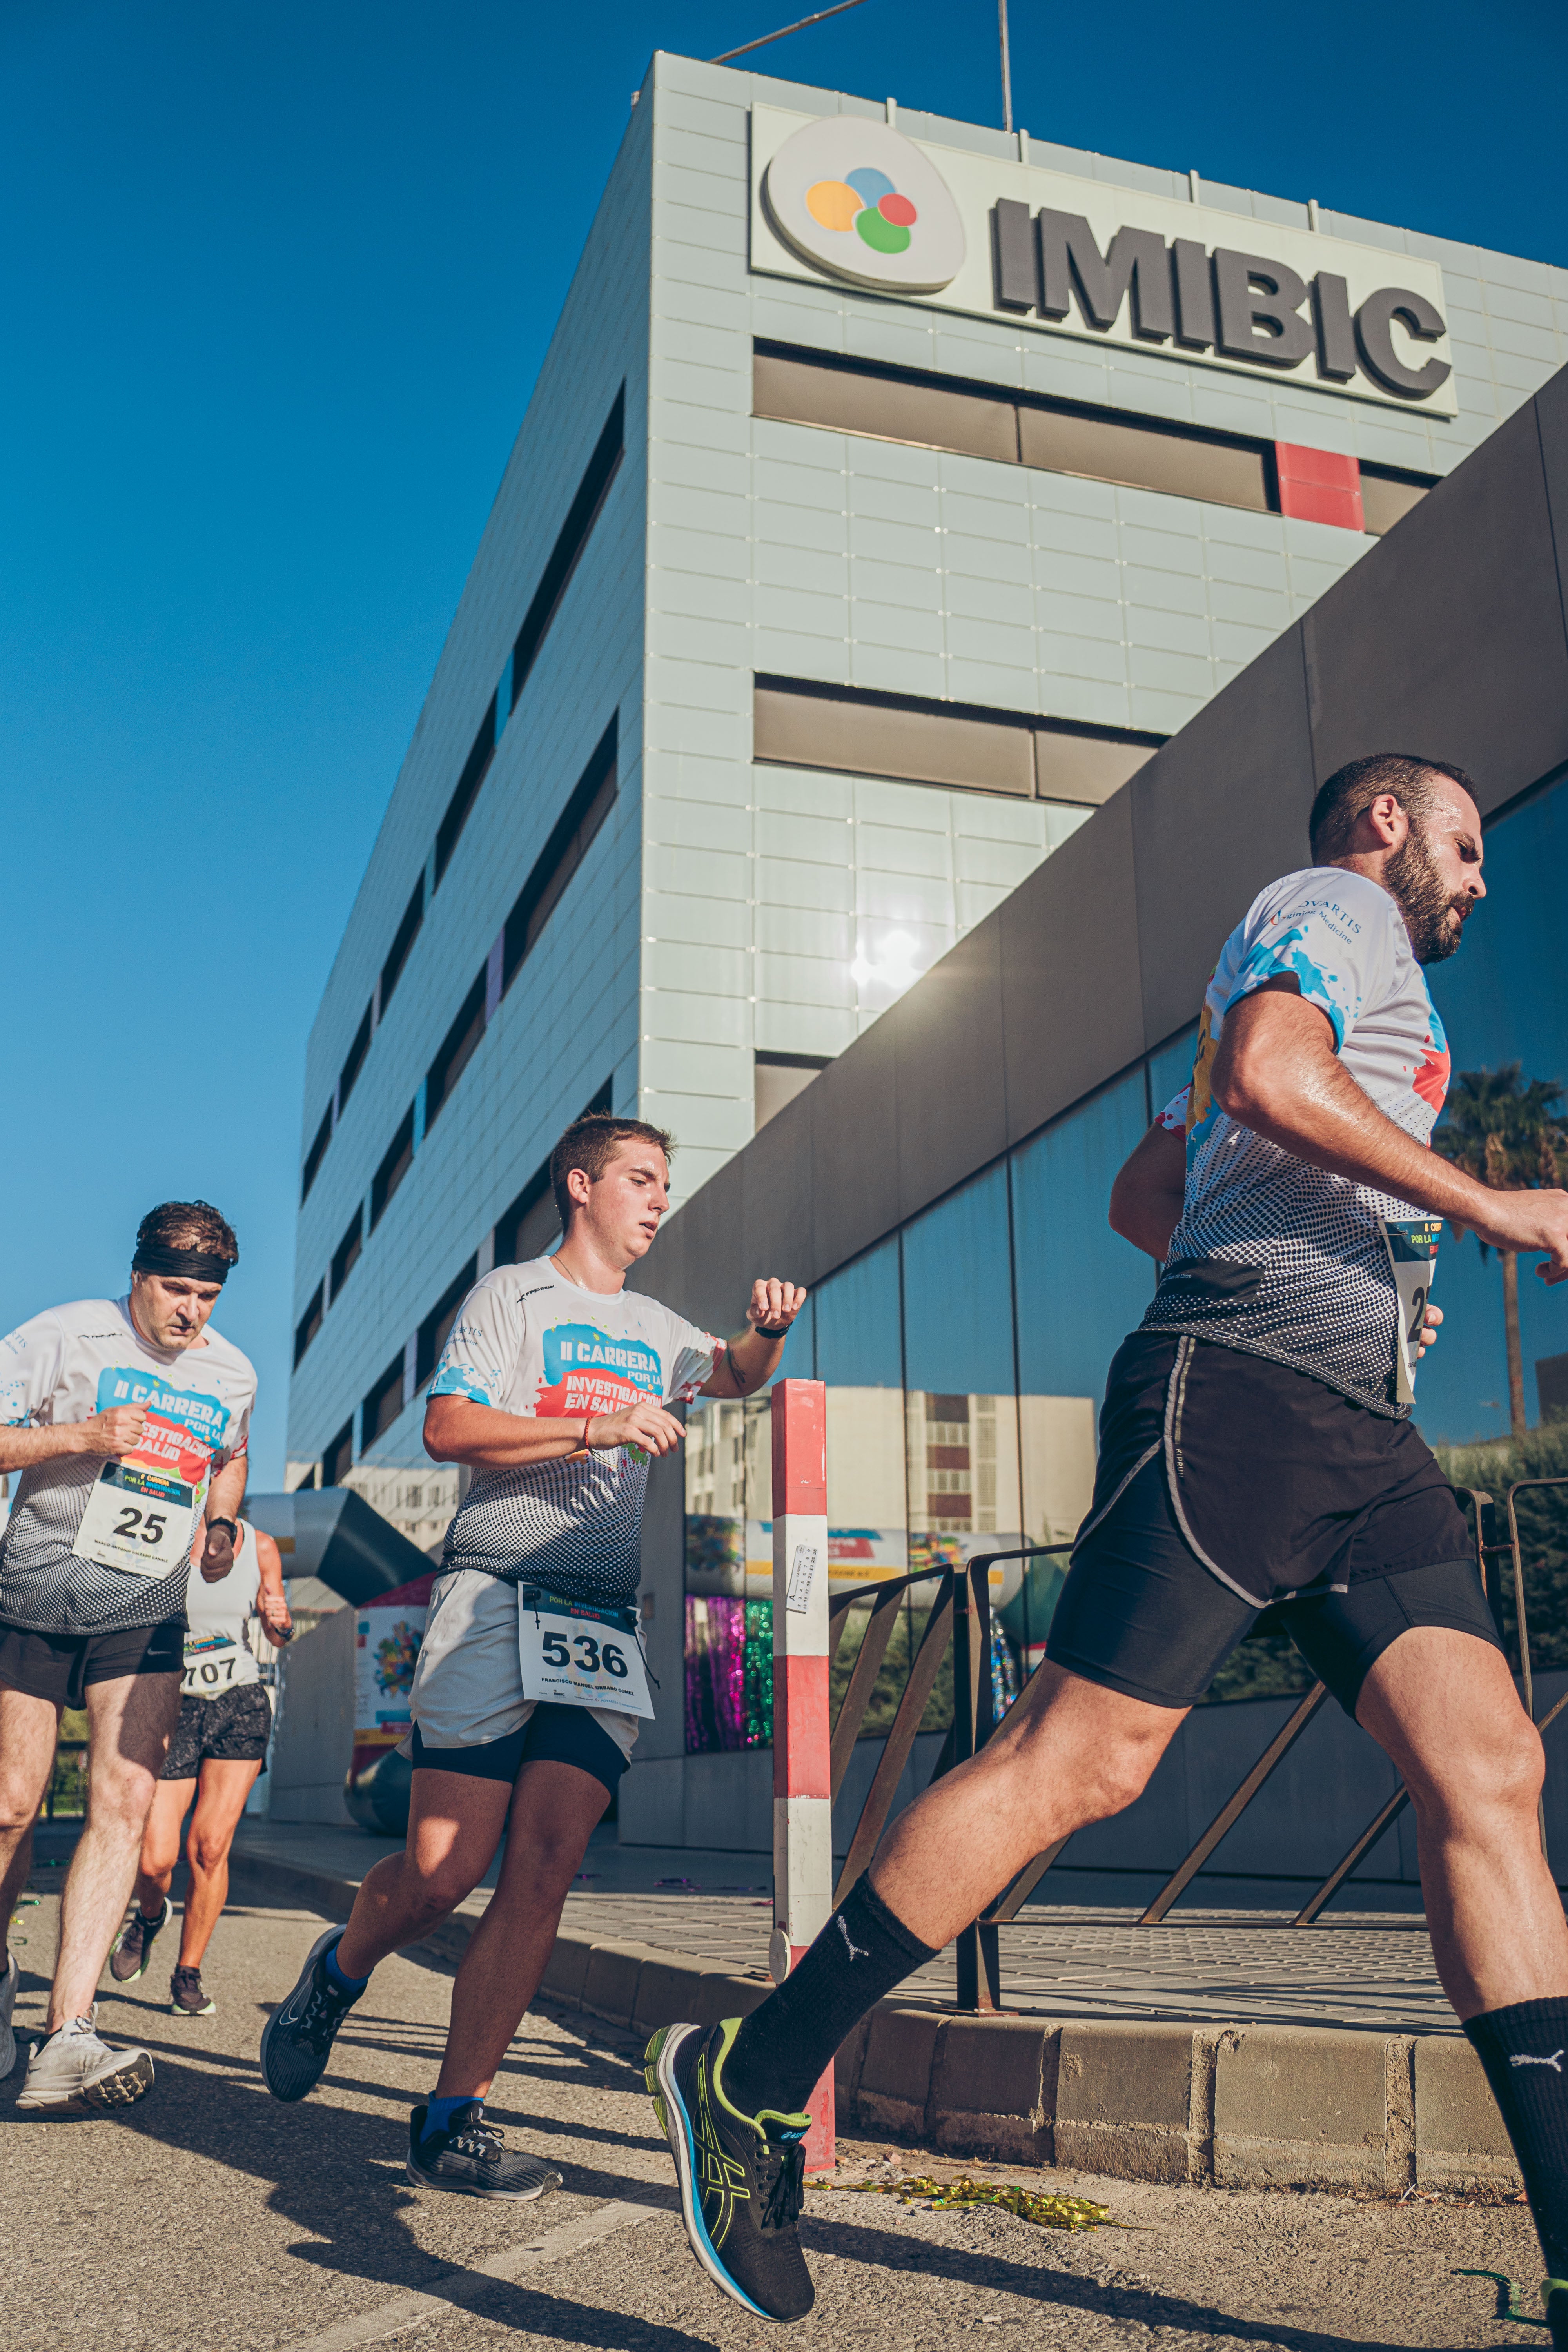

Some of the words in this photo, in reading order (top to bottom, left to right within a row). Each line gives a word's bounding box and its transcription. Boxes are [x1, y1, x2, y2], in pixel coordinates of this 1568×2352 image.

[989, 196, 1453, 401] IMIBIC
[1286, 910, 1317, 920] gining
[1319, 911, 1352, 944] Medicine
[1298, 900, 1361, 934] OVARTIS
[1411, 1235, 1423, 1243] POR
[1424, 1234, 1432, 1243] LA
[1407, 1284, 1431, 1343] 2
[560, 1341, 572, 1361] II
[577, 1343, 658, 1373] CARRERA
[627, 1370, 650, 1383] POR
[652, 1375, 661, 1385] LA
[113, 1379, 129, 1399] II
[131, 1385, 223, 1430] CARRERA
[564, 1392, 590, 1410] EN
[184, 1418, 213, 1434] POR
[212, 1428, 222, 1442] LA
[1176, 1448, 1184, 1477] KIPRUN
[124, 1475, 136, 1484] POR
[149, 1488, 165, 1498] SALUD
[113, 1507, 167, 1543] 25
[549, 1596, 563, 1604] POR
[580, 1609, 601, 1619] SALUD
[541, 1631, 628, 1678] 536
[187, 1658, 236, 1686] 707
[573, 1681, 594, 1690] MANUEL
[618, 1688, 635, 1696] GOMEZ
